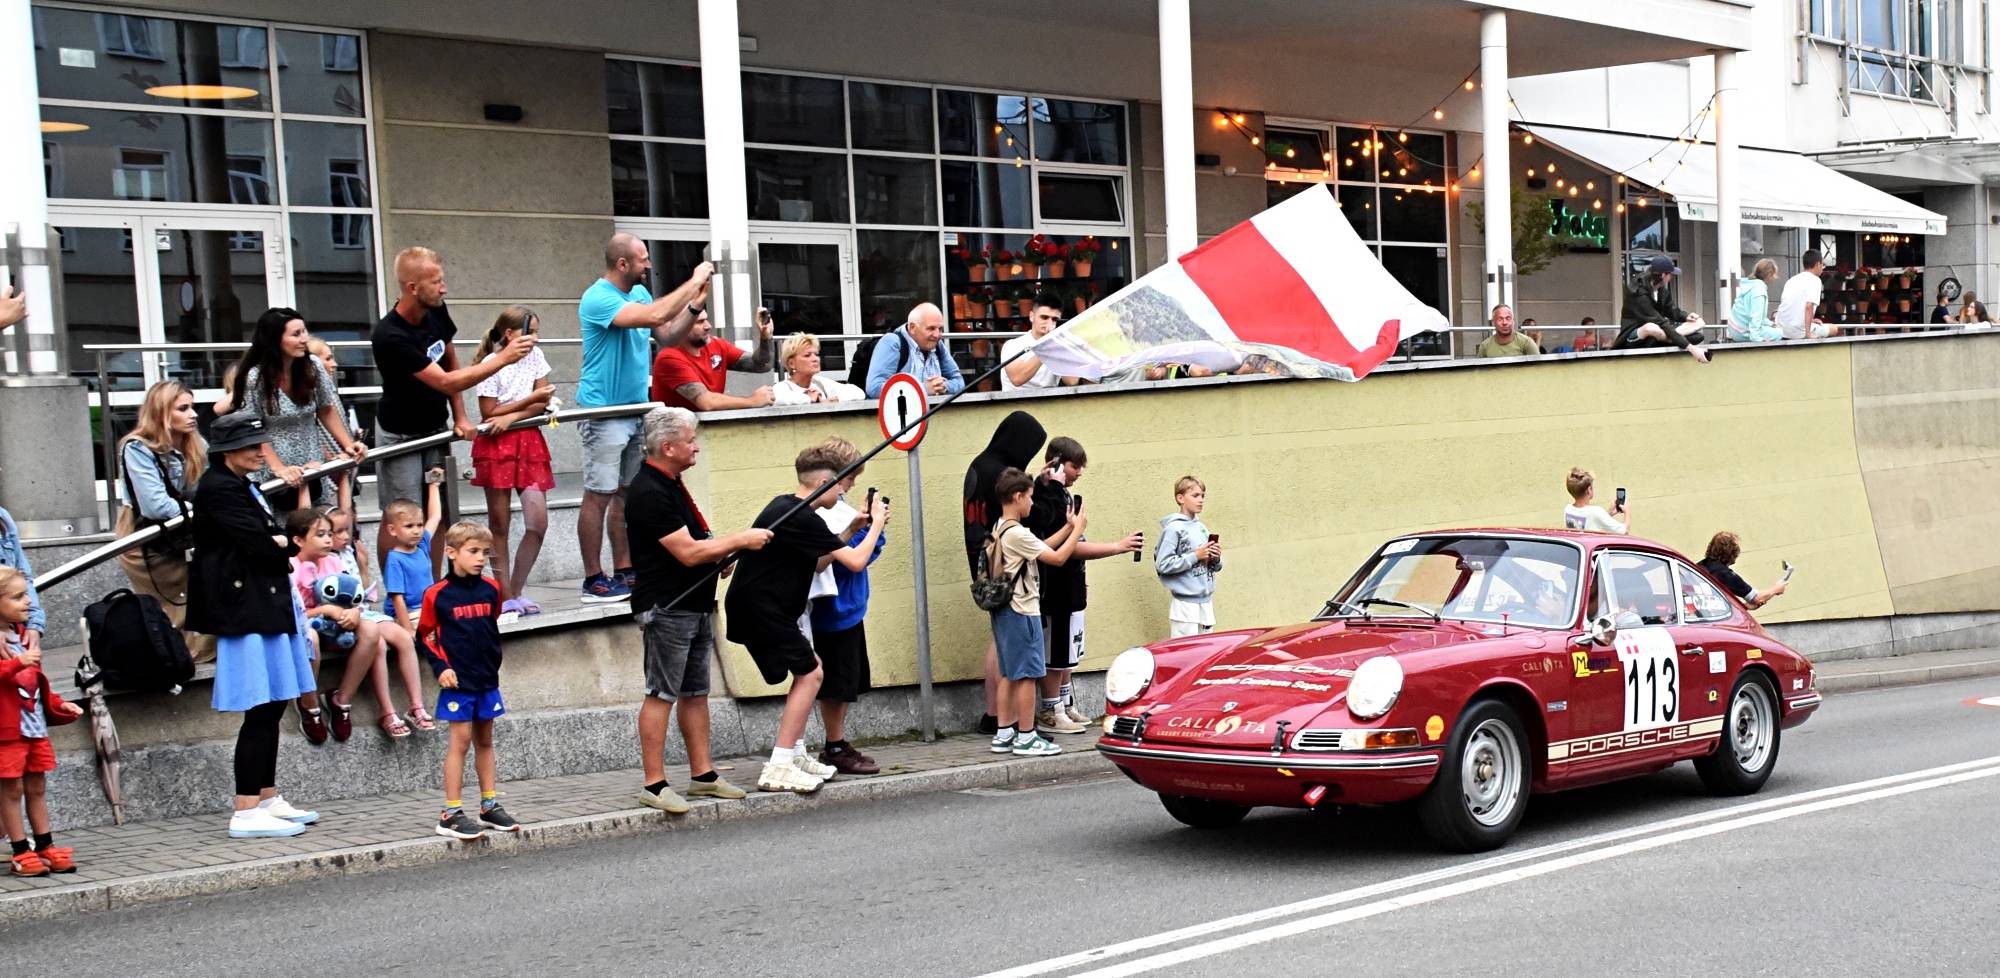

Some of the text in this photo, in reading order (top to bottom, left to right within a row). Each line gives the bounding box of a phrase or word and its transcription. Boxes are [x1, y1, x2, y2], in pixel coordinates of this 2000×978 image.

[453, 603, 491, 620] PUMA
[1240, 678, 1291, 687] Centrum
[1291, 681, 1331, 692] Sopot
[1628, 657, 1677, 725] 113
[1569, 725, 1689, 756] PORSCHE
